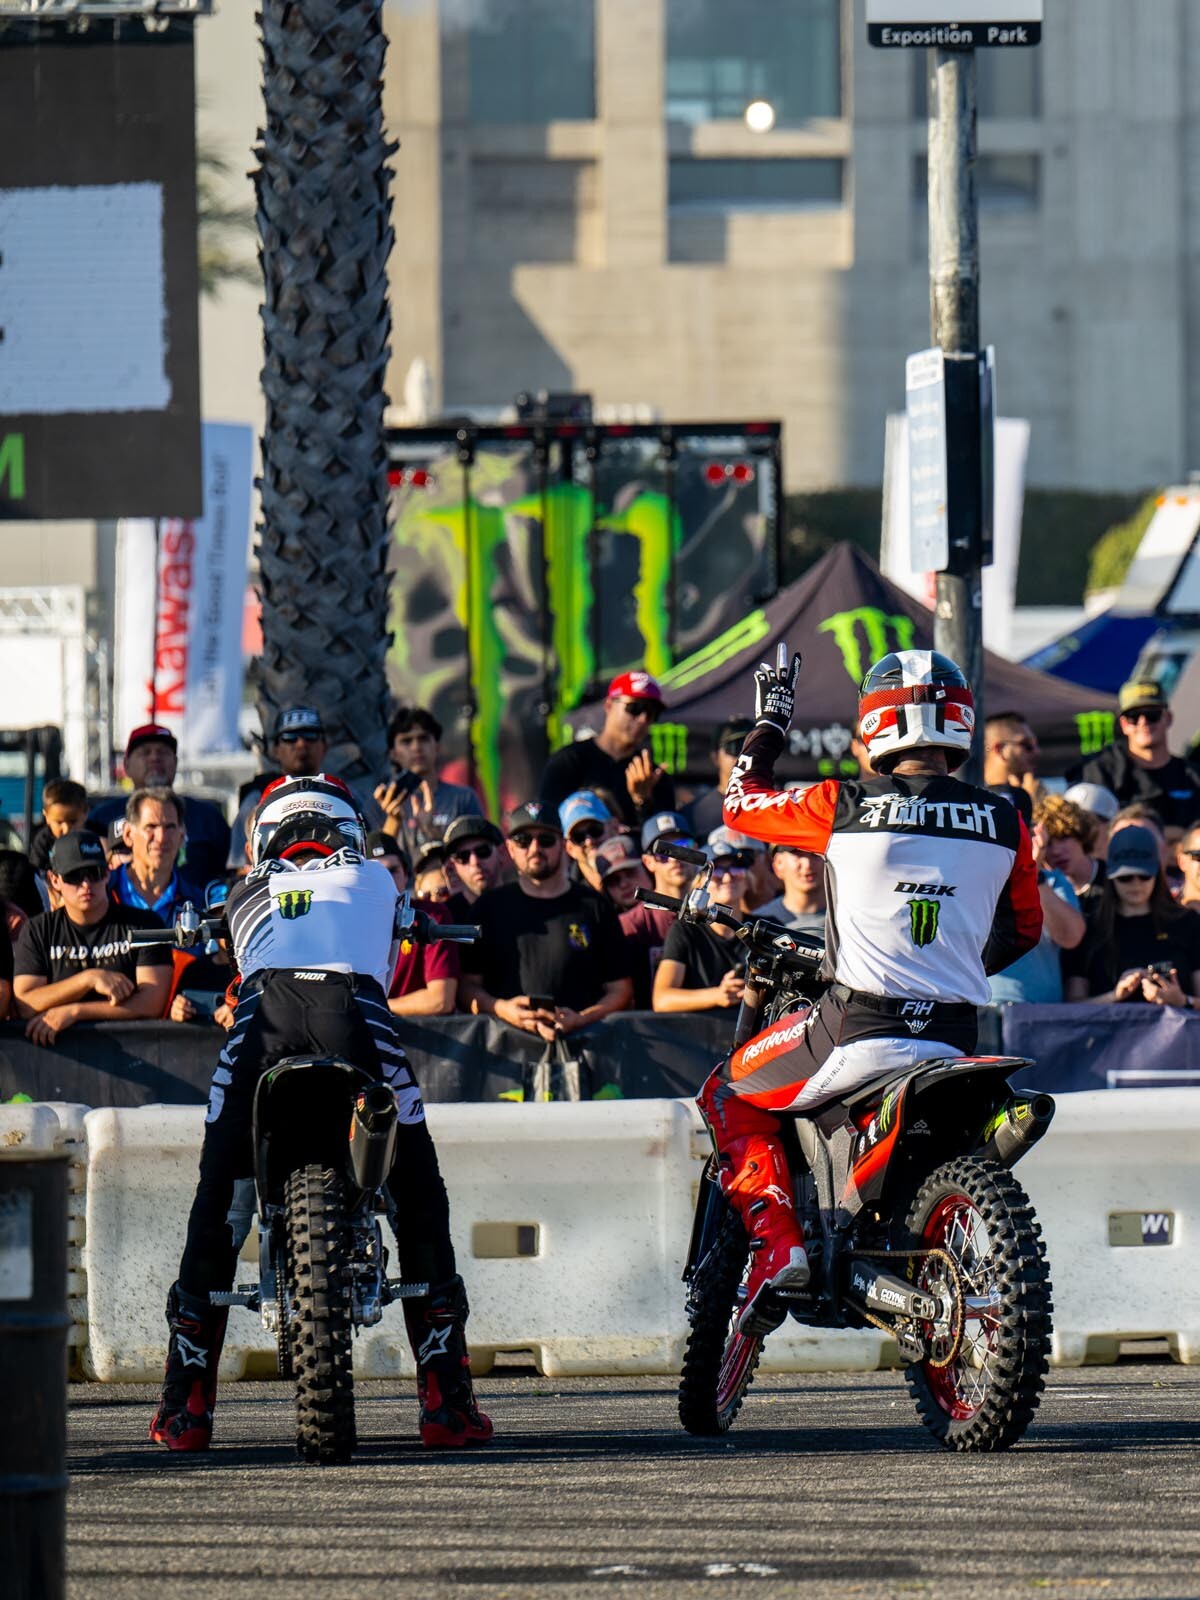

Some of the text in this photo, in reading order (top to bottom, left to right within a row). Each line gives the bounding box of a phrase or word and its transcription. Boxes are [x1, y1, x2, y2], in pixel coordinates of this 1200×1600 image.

[881, 26, 1027, 47] Exposition Park
[146, 517, 196, 715] Kawas
[864, 716, 879, 729] BELL
[894, 881, 958, 897] DBK
[91, 940, 130, 959] MOTO
[294, 971, 327, 982] THOR
[881, 1288, 906, 1304] COYNE
